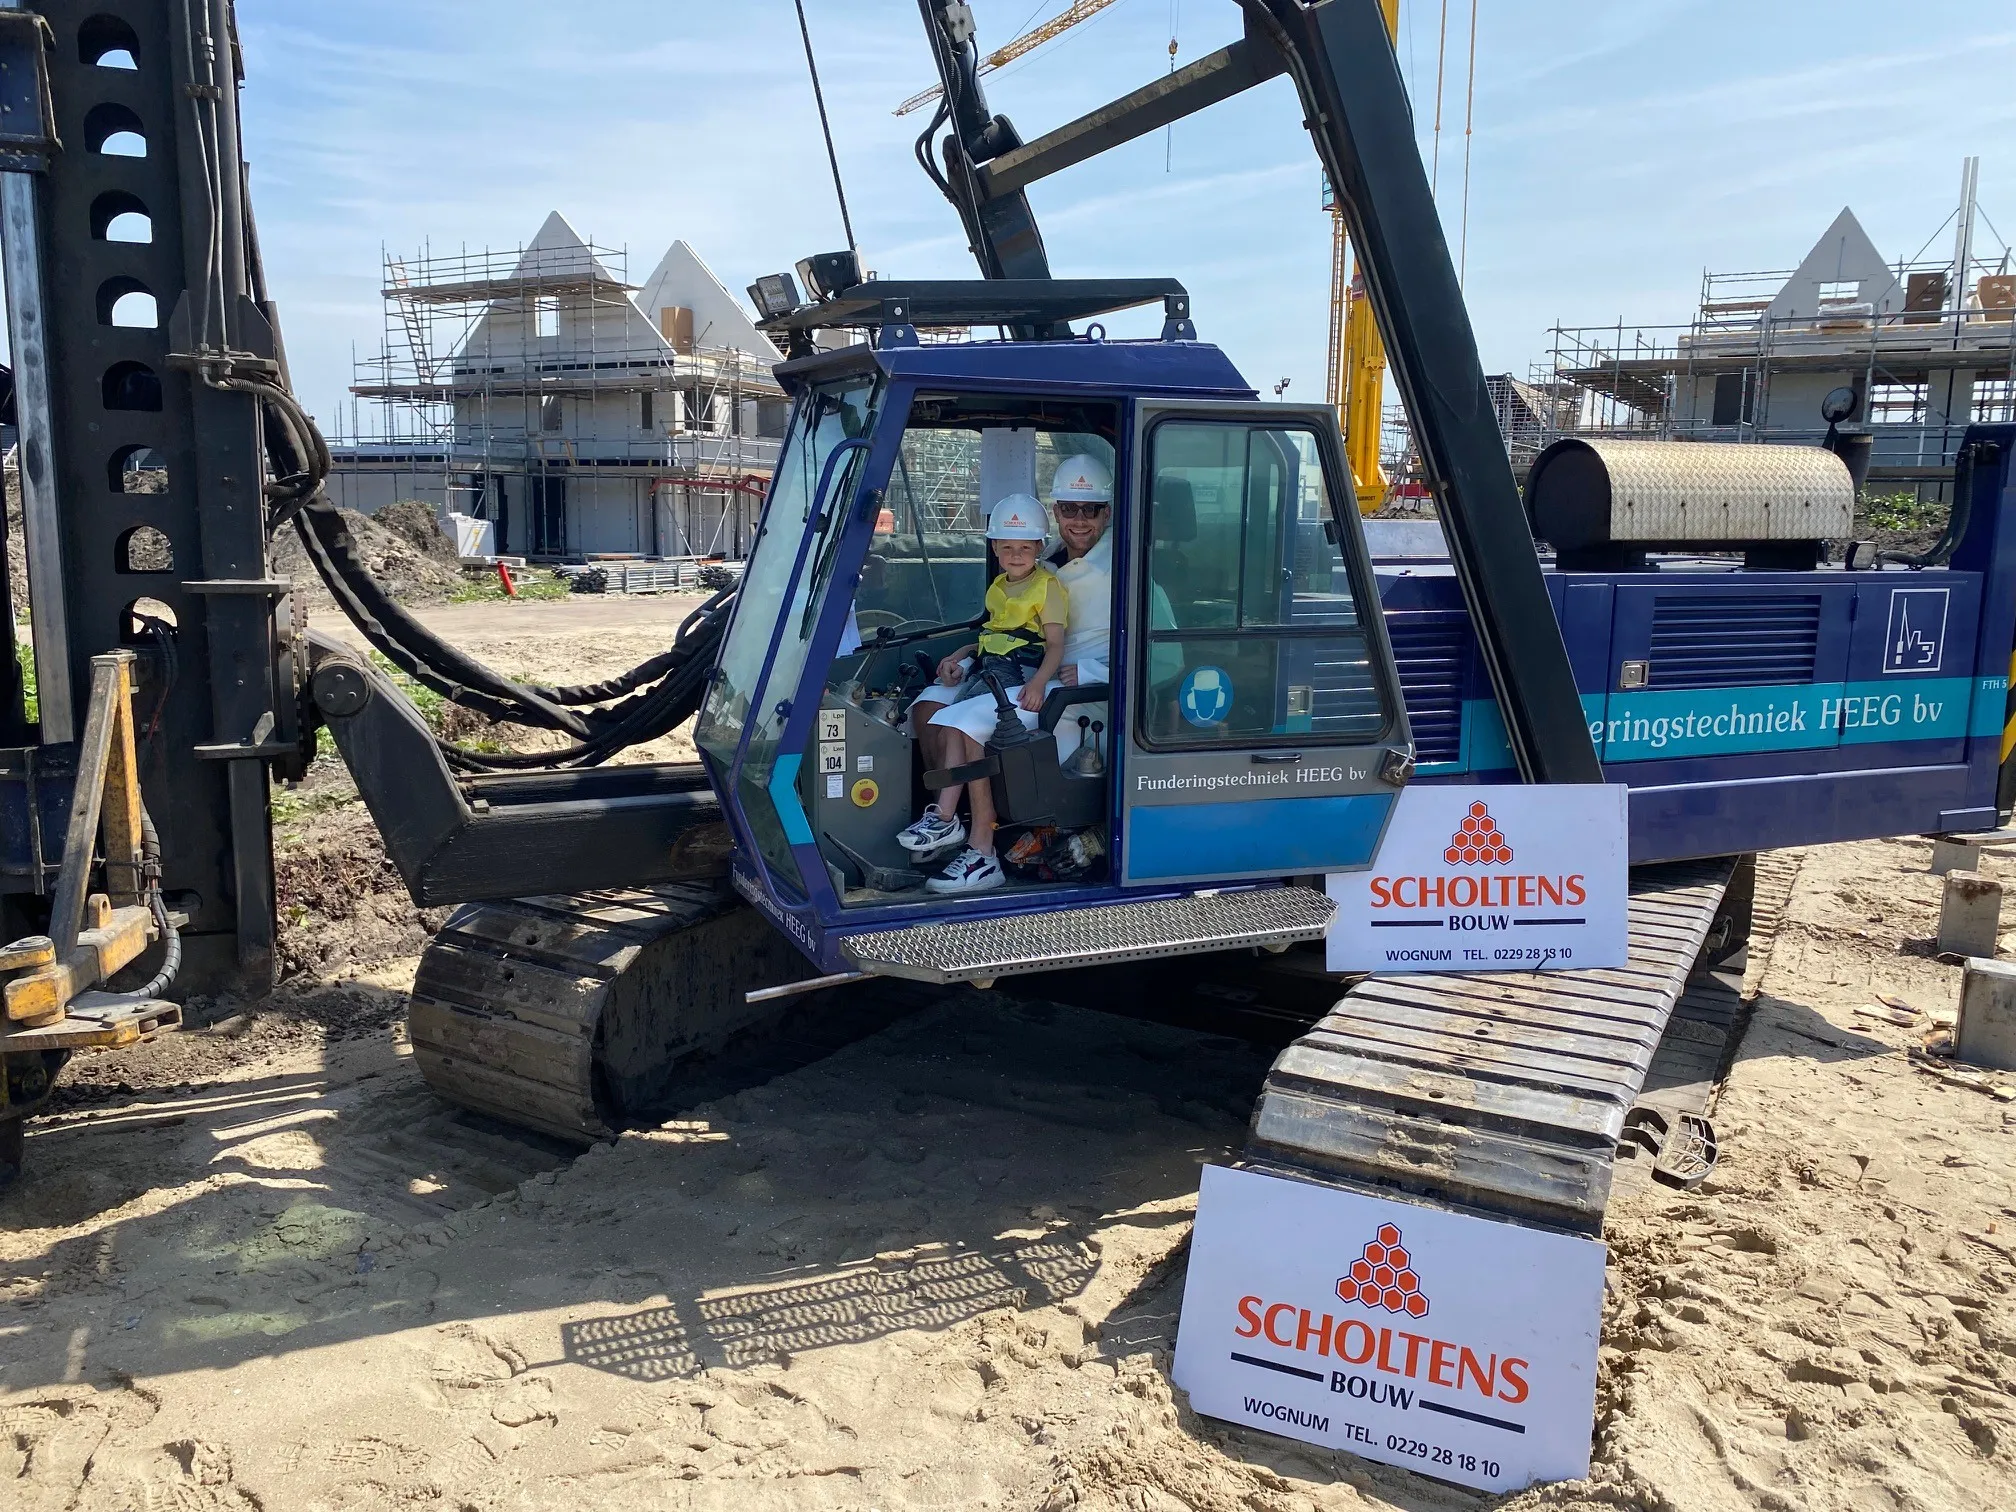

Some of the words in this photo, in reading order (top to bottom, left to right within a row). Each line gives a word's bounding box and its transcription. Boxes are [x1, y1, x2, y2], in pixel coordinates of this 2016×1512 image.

[1982, 680, 2000, 690] FTH
[826, 724, 839, 738] 73
[1583, 700, 1806, 748] eringstechniek
[1819, 694, 1902, 730] HEEG
[1912, 693, 1943, 723] bv
[825, 756, 842, 770] 104
[1137, 769, 1289, 791] Funderingstechniek
[1295, 767, 1343, 783] HEEG
[1349, 767, 1367, 781] bv
[1369, 874, 1587, 908] SCHOLTENS
[785, 912, 806, 943] HEEG
[807, 930, 816, 953] bv
[1449, 915, 1510, 931] BOUW
[1386, 949, 1452, 961] WOGNUM
[1463, 949, 1488, 960] TEL.
[1494, 949, 1523, 960] 0229
[1525, 948, 1541, 960] 28
[1543, 948, 1556, 959] 18
[1559, 947, 1572, 959] 10
[1234, 1295, 1530, 1404] SCHOLTENS
[1330, 1370, 1415, 1410] BOUW
[1243, 1396, 1330, 1433] WOGNUM
[1344, 1422, 1378, 1446] TEL.
[1386, 1434, 1428, 1459] 0229
[1431, 1446, 1453, 1466] 28
[1457, 1452, 1476, 1472] 18
[1481, 1459, 1501, 1478] 10
